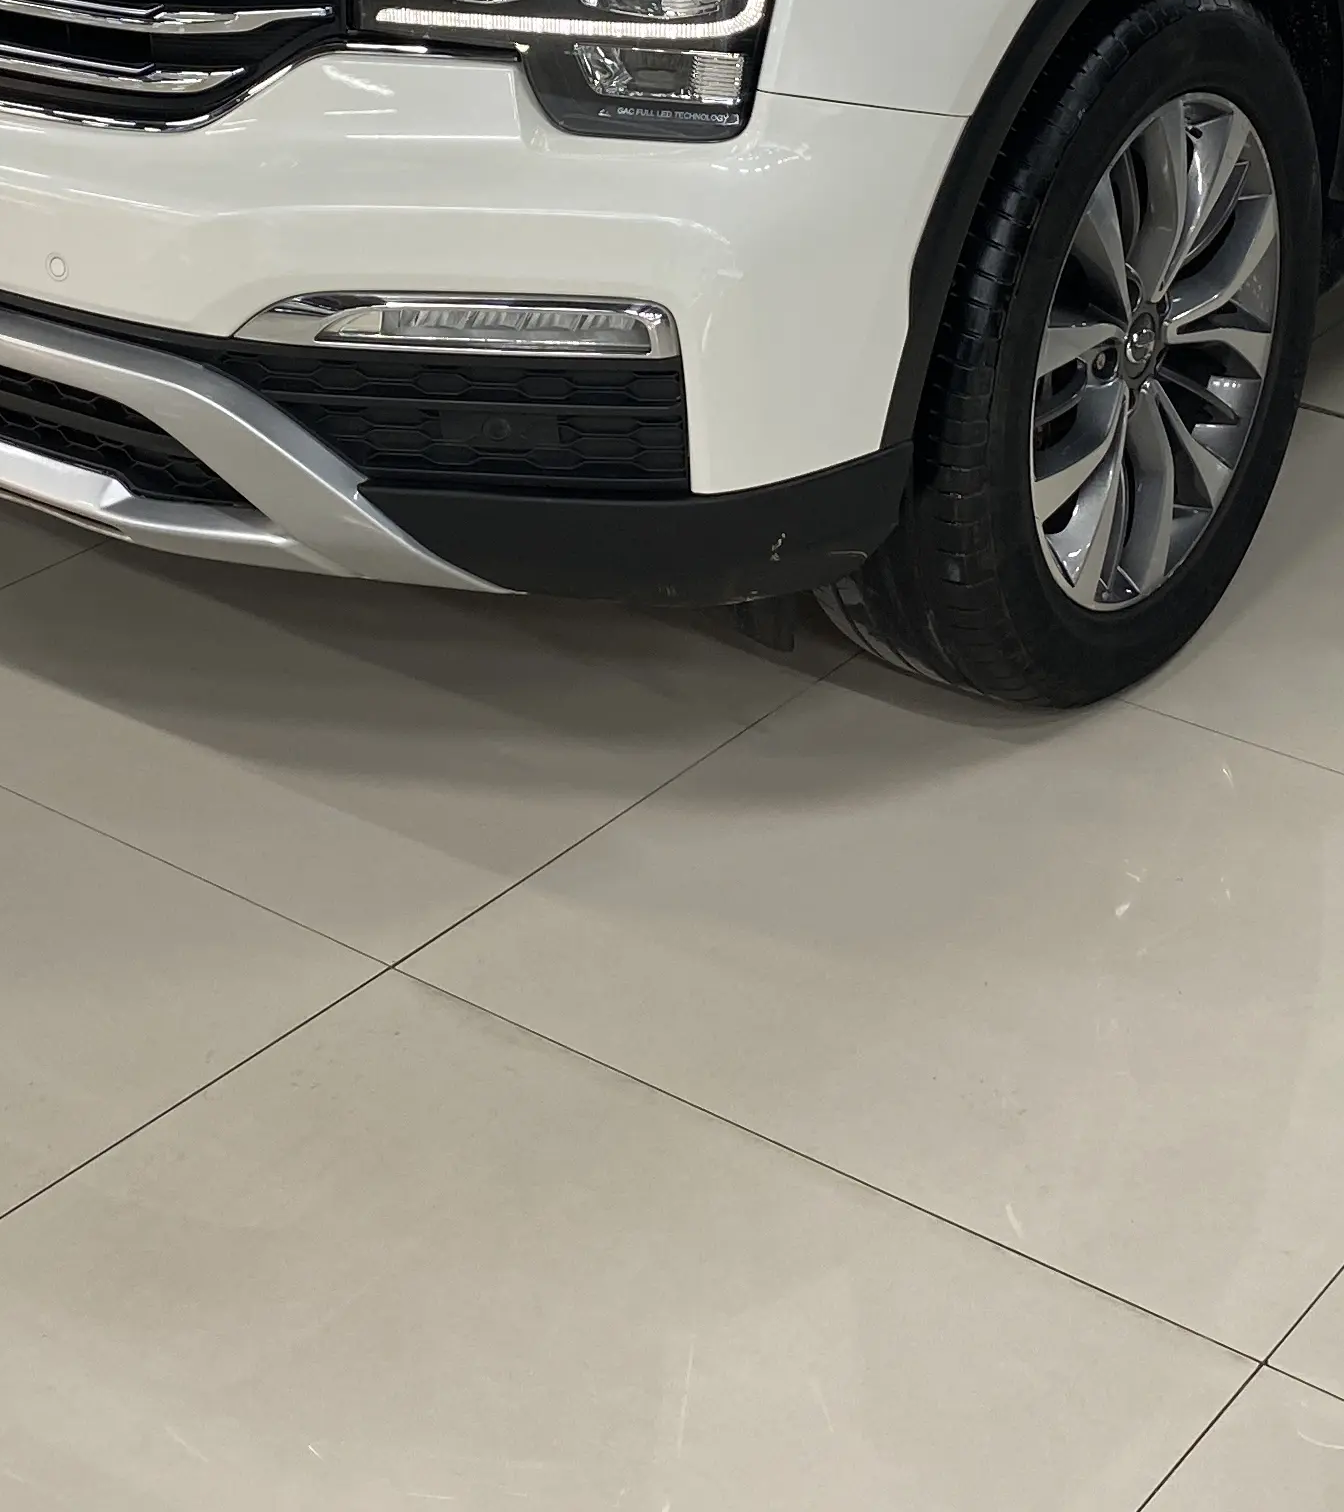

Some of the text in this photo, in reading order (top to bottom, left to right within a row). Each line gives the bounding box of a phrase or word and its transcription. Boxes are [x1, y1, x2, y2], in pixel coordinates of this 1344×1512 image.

[617, 106, 729, 123] GAC FULL LED TECHNOLOGY
